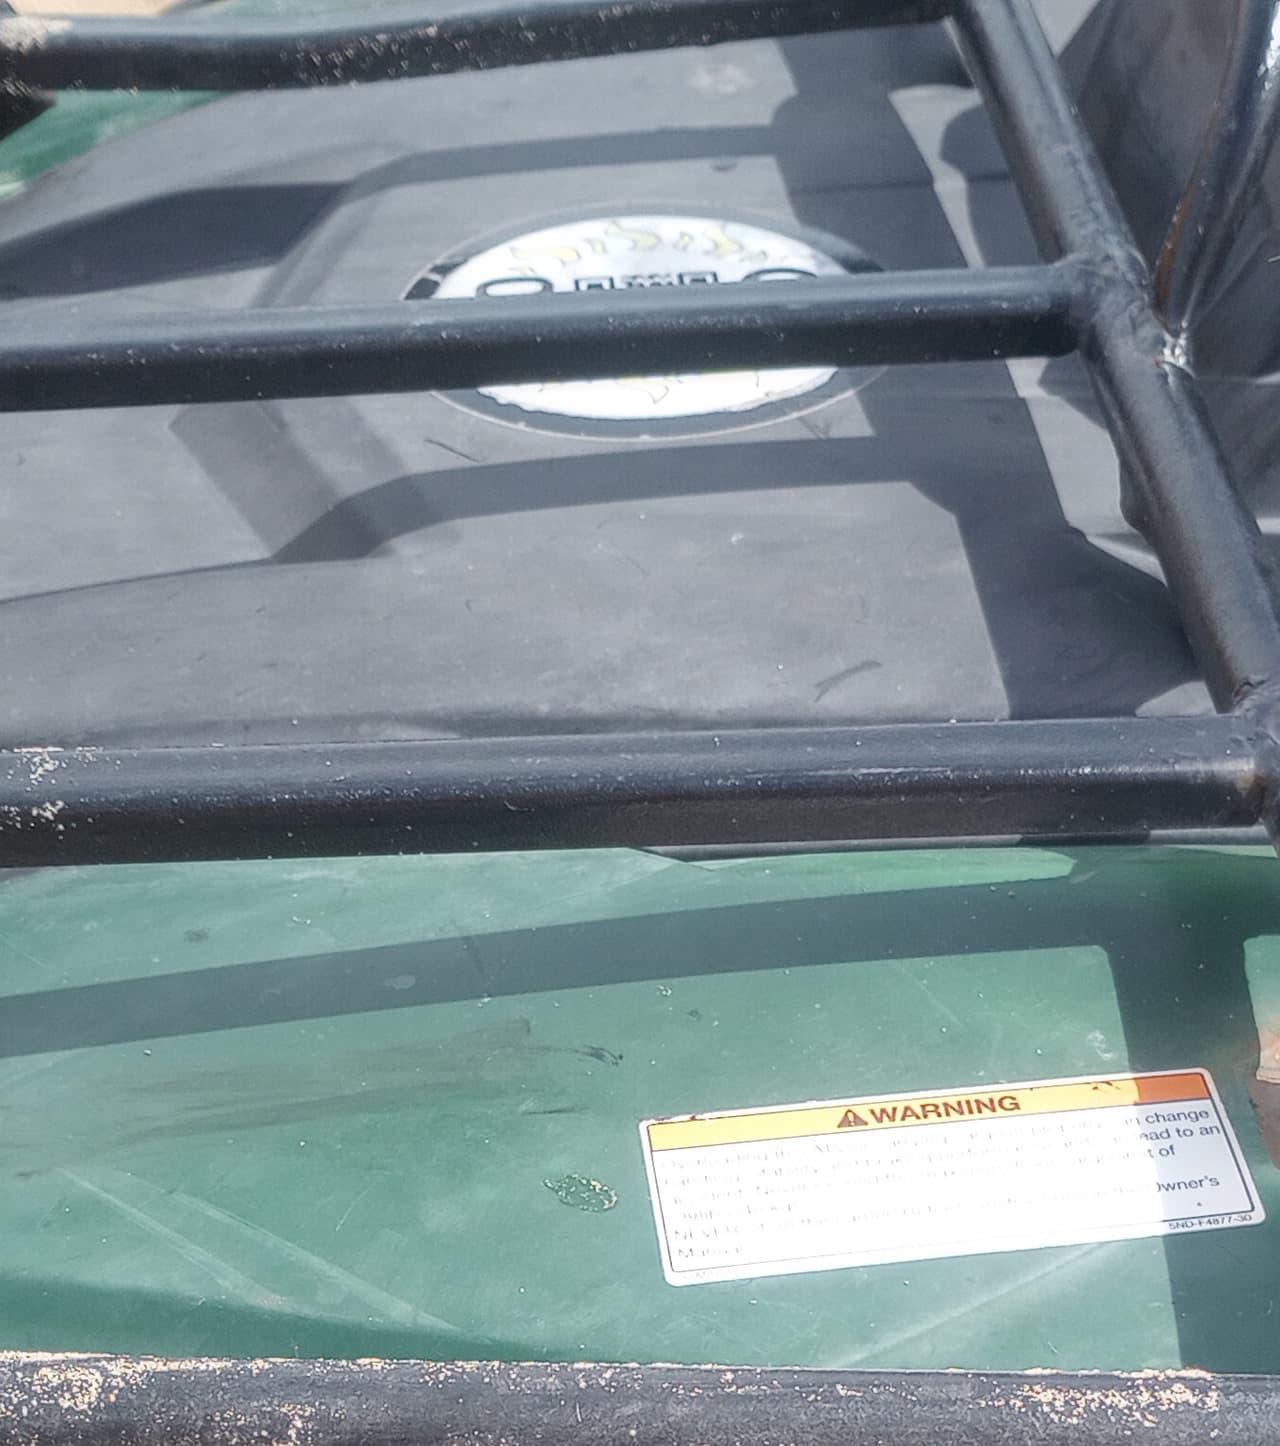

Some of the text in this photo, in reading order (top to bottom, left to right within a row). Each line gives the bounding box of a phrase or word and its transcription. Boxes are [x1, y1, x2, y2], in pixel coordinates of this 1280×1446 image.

[869, 1095, 1021, 1124] WARNING
[1145, 1110, 1210, 1125] change
[1175, 1126, 1194, 1138] to
[1199, 1124, 1221, 1136] an
[1158, 1144, 1176, 1158] of
